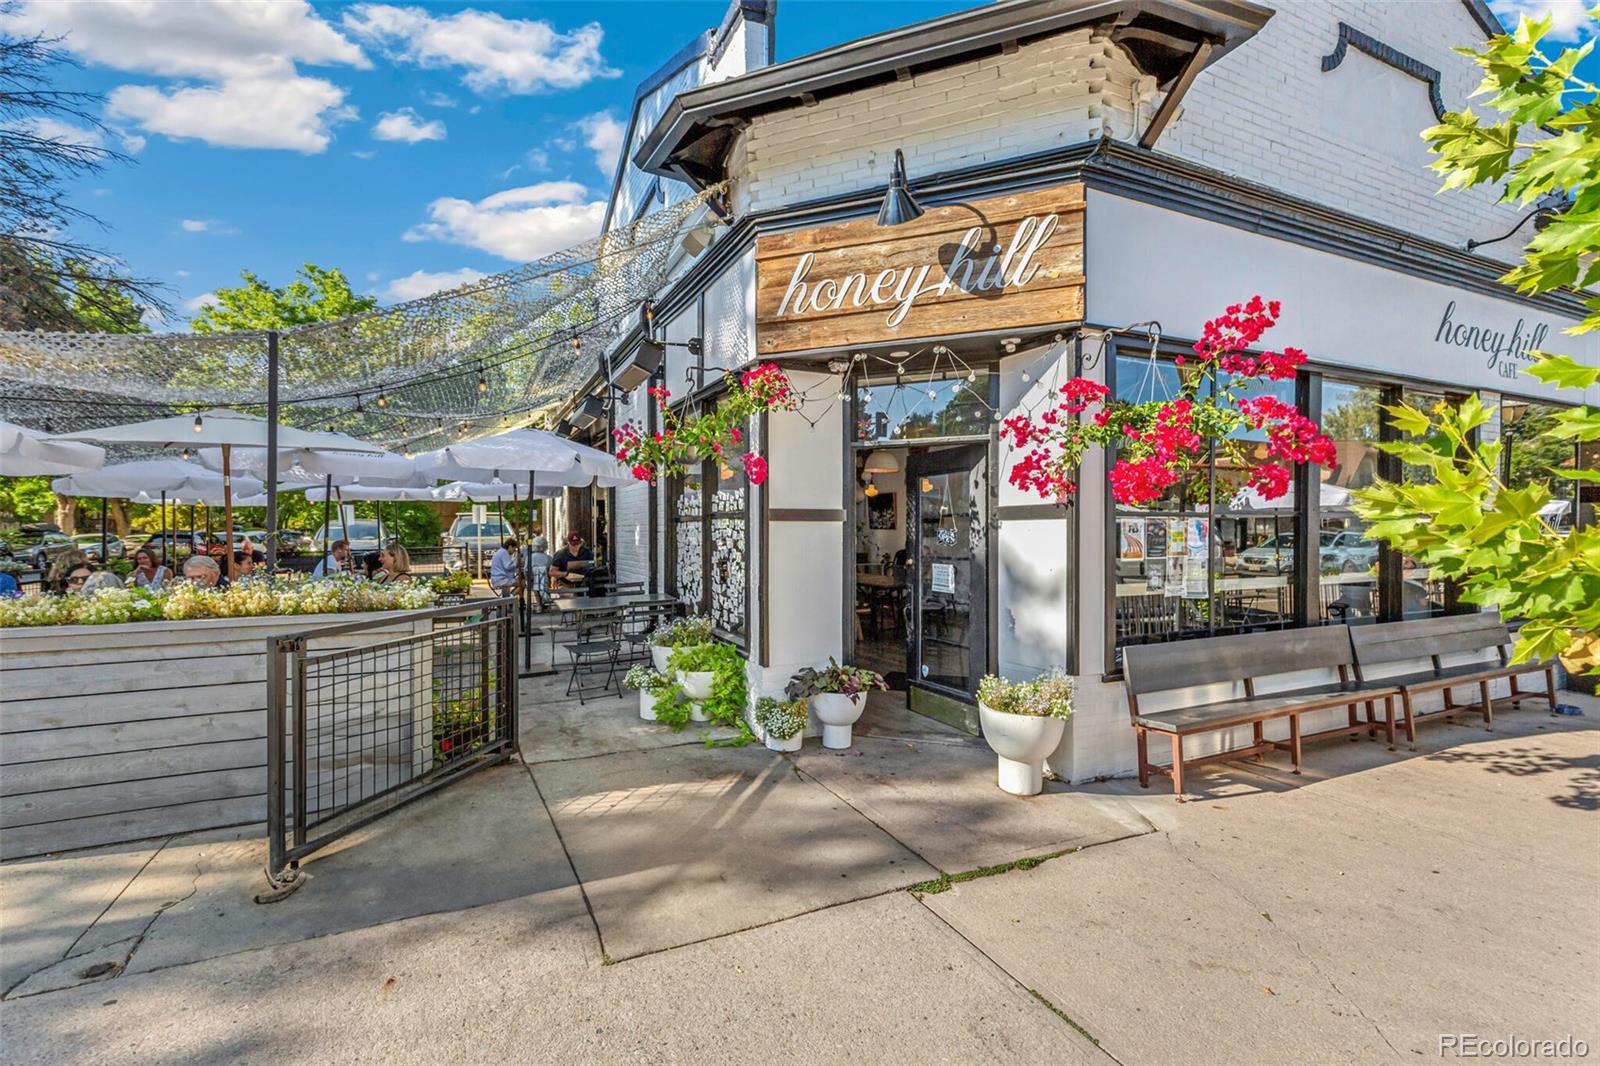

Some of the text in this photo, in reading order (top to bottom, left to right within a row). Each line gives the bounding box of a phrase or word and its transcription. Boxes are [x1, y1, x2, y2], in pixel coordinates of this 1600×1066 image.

[777, 213, 1060, 328] honey hill
[1434, 300, 1549, 370] honey hill
[1498, 361, 1519, 380] CAFE
